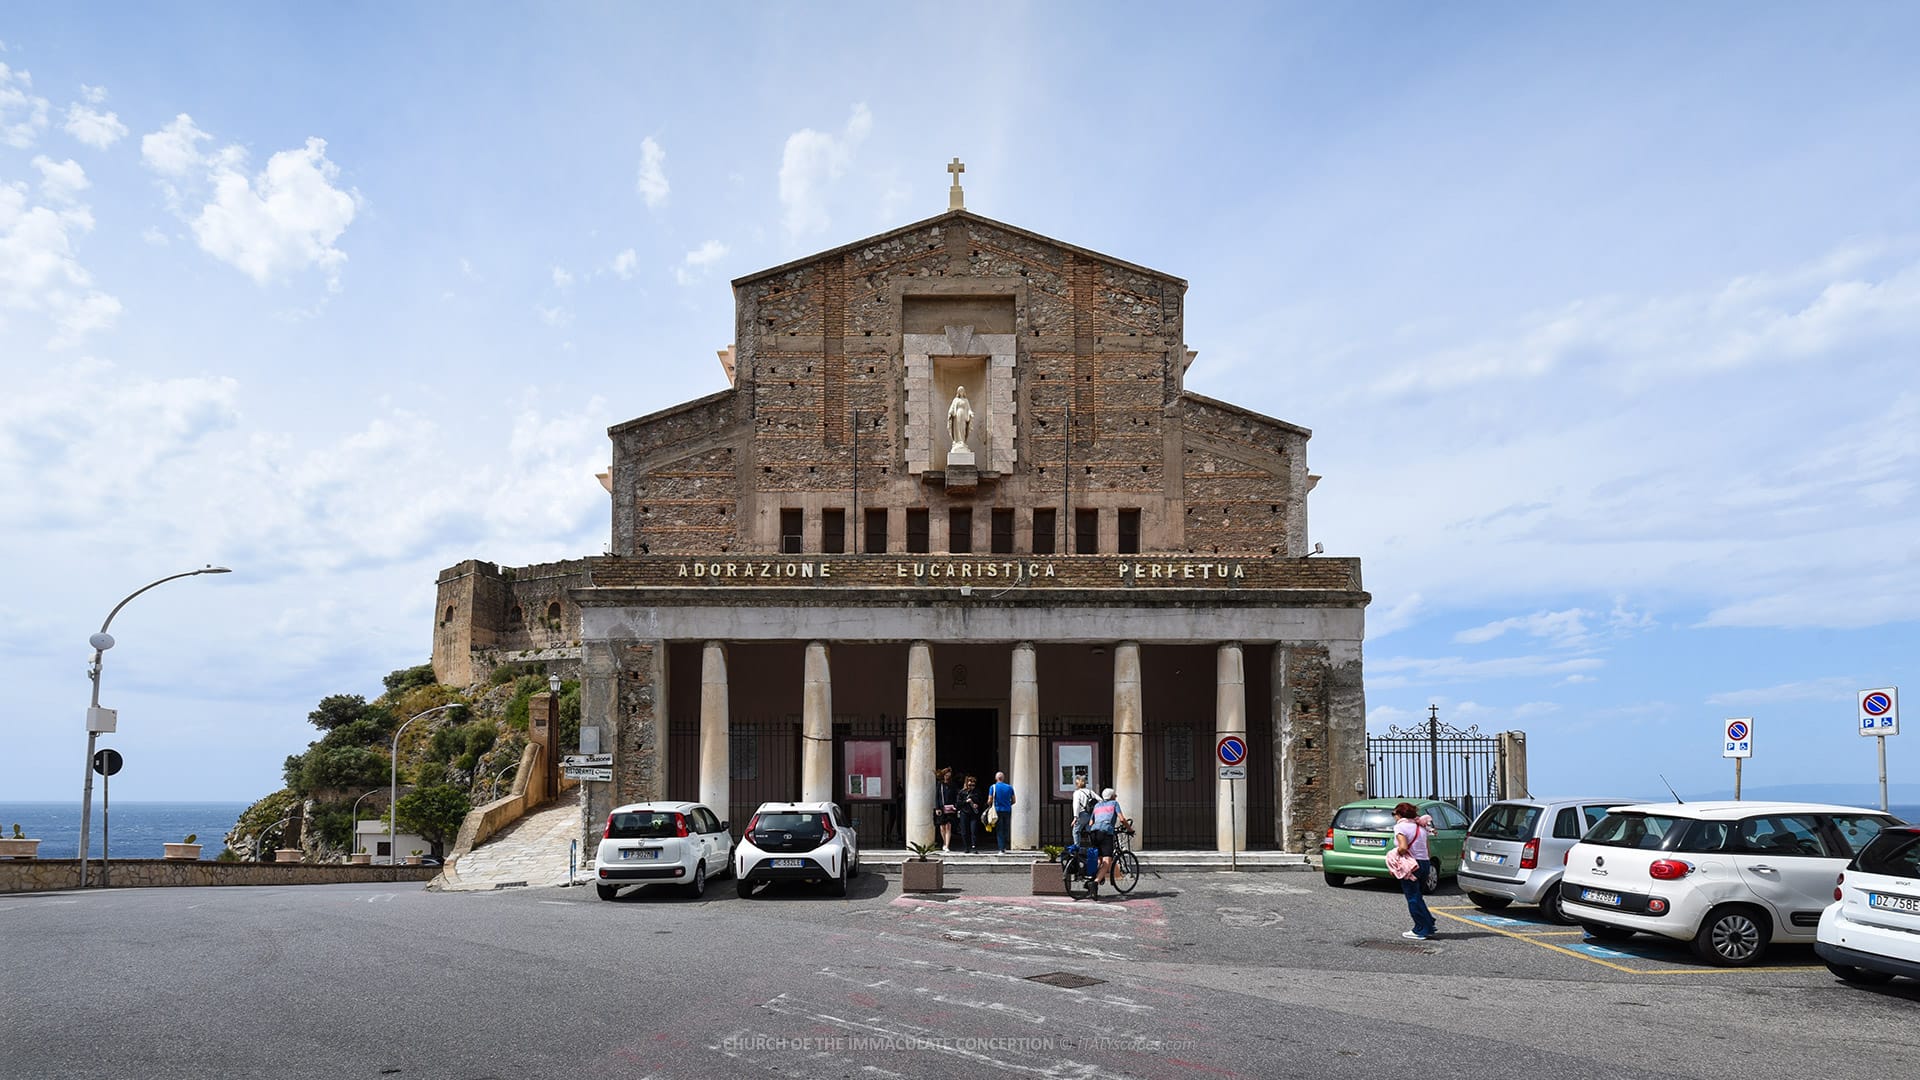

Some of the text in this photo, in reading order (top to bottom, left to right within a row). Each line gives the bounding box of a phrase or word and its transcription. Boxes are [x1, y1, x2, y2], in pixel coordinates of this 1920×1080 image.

[678, 562, 831, 578] ADORAZIONE
[897, 562, 1056, 578] EUCARISTICA
[1876, 895, 1888, 906] DZ
